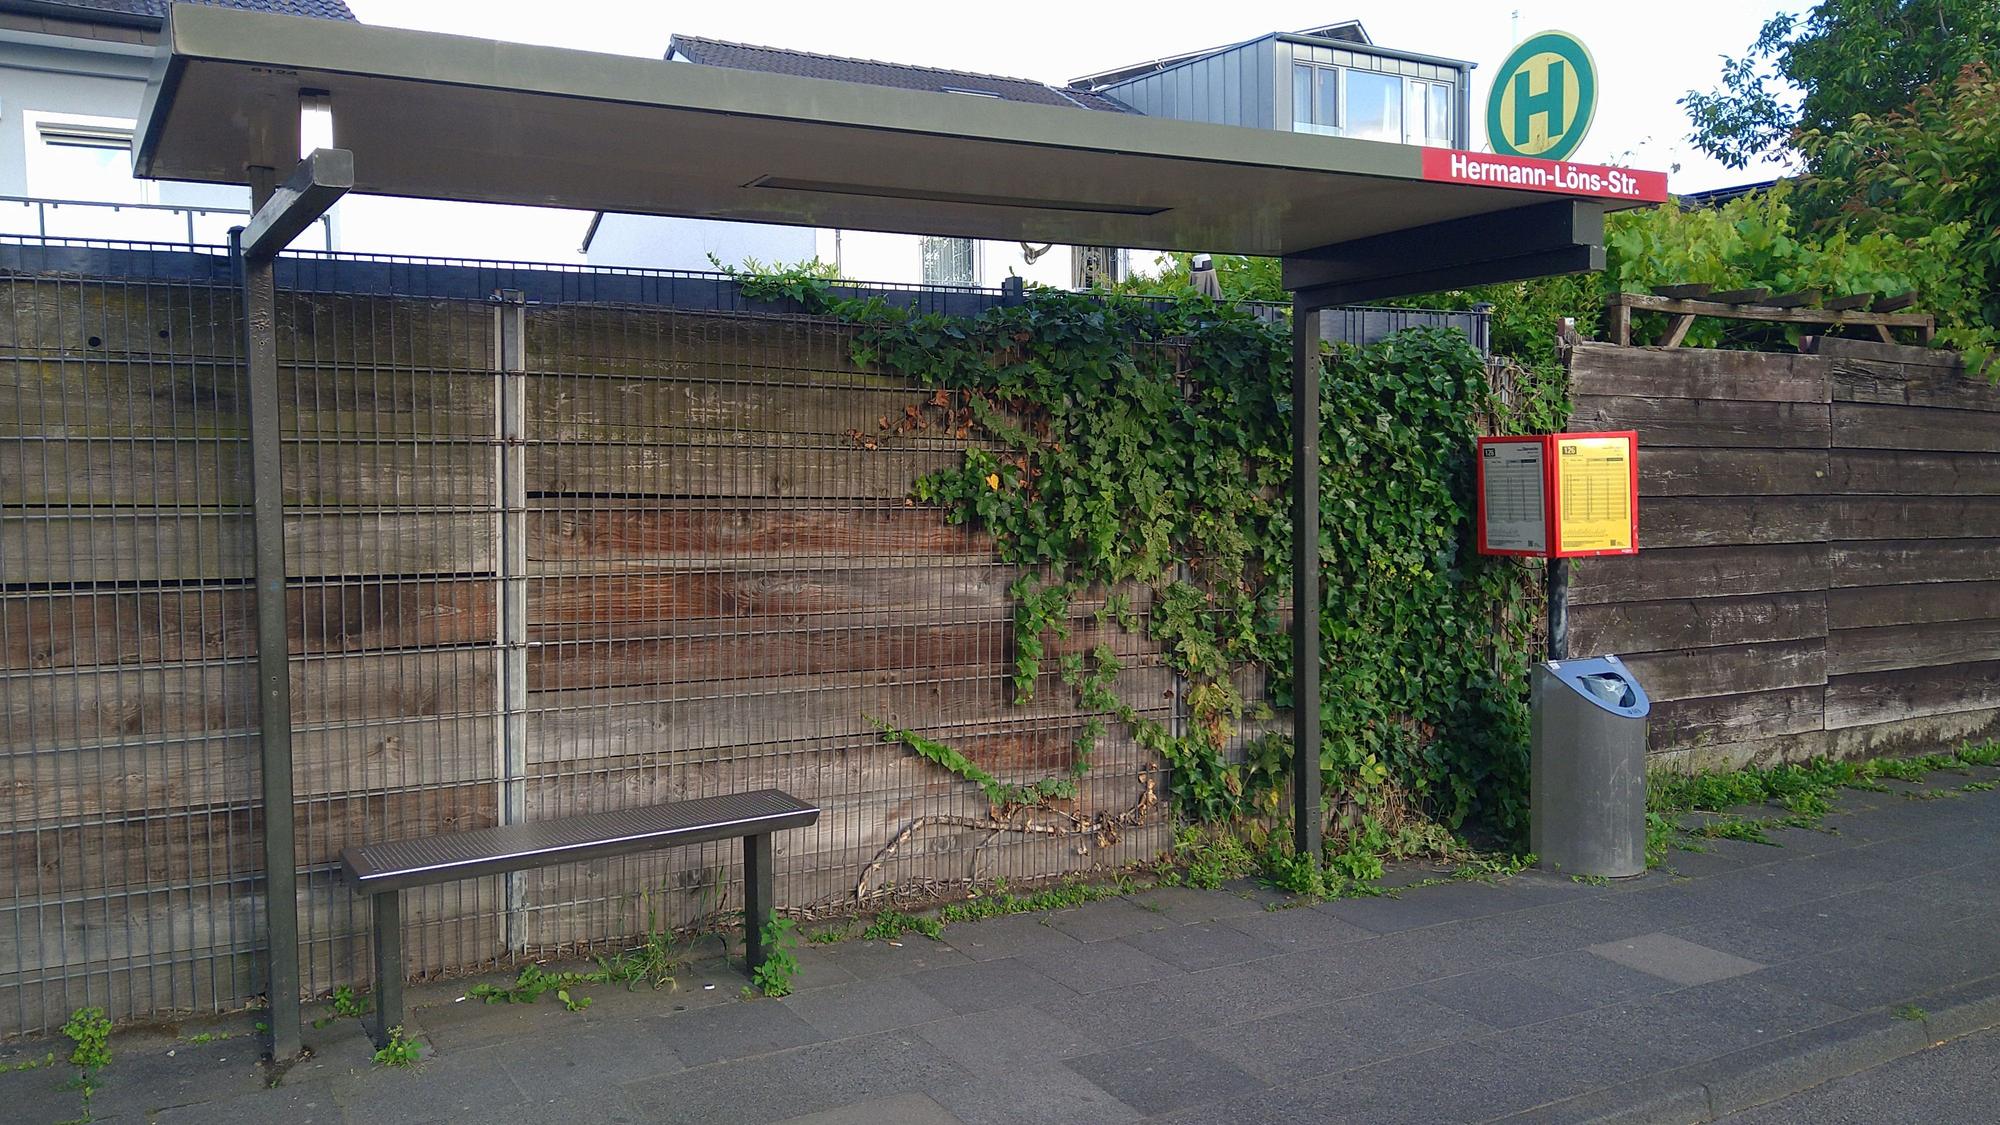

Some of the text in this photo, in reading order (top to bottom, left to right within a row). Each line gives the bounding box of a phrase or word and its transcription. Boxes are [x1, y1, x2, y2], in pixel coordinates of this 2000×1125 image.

[1514, 60, 1564, 146] H
[1451, 154, 1640, 195] Hermann-Löns-Str.
[1564, 446, 1576, 454] 126
